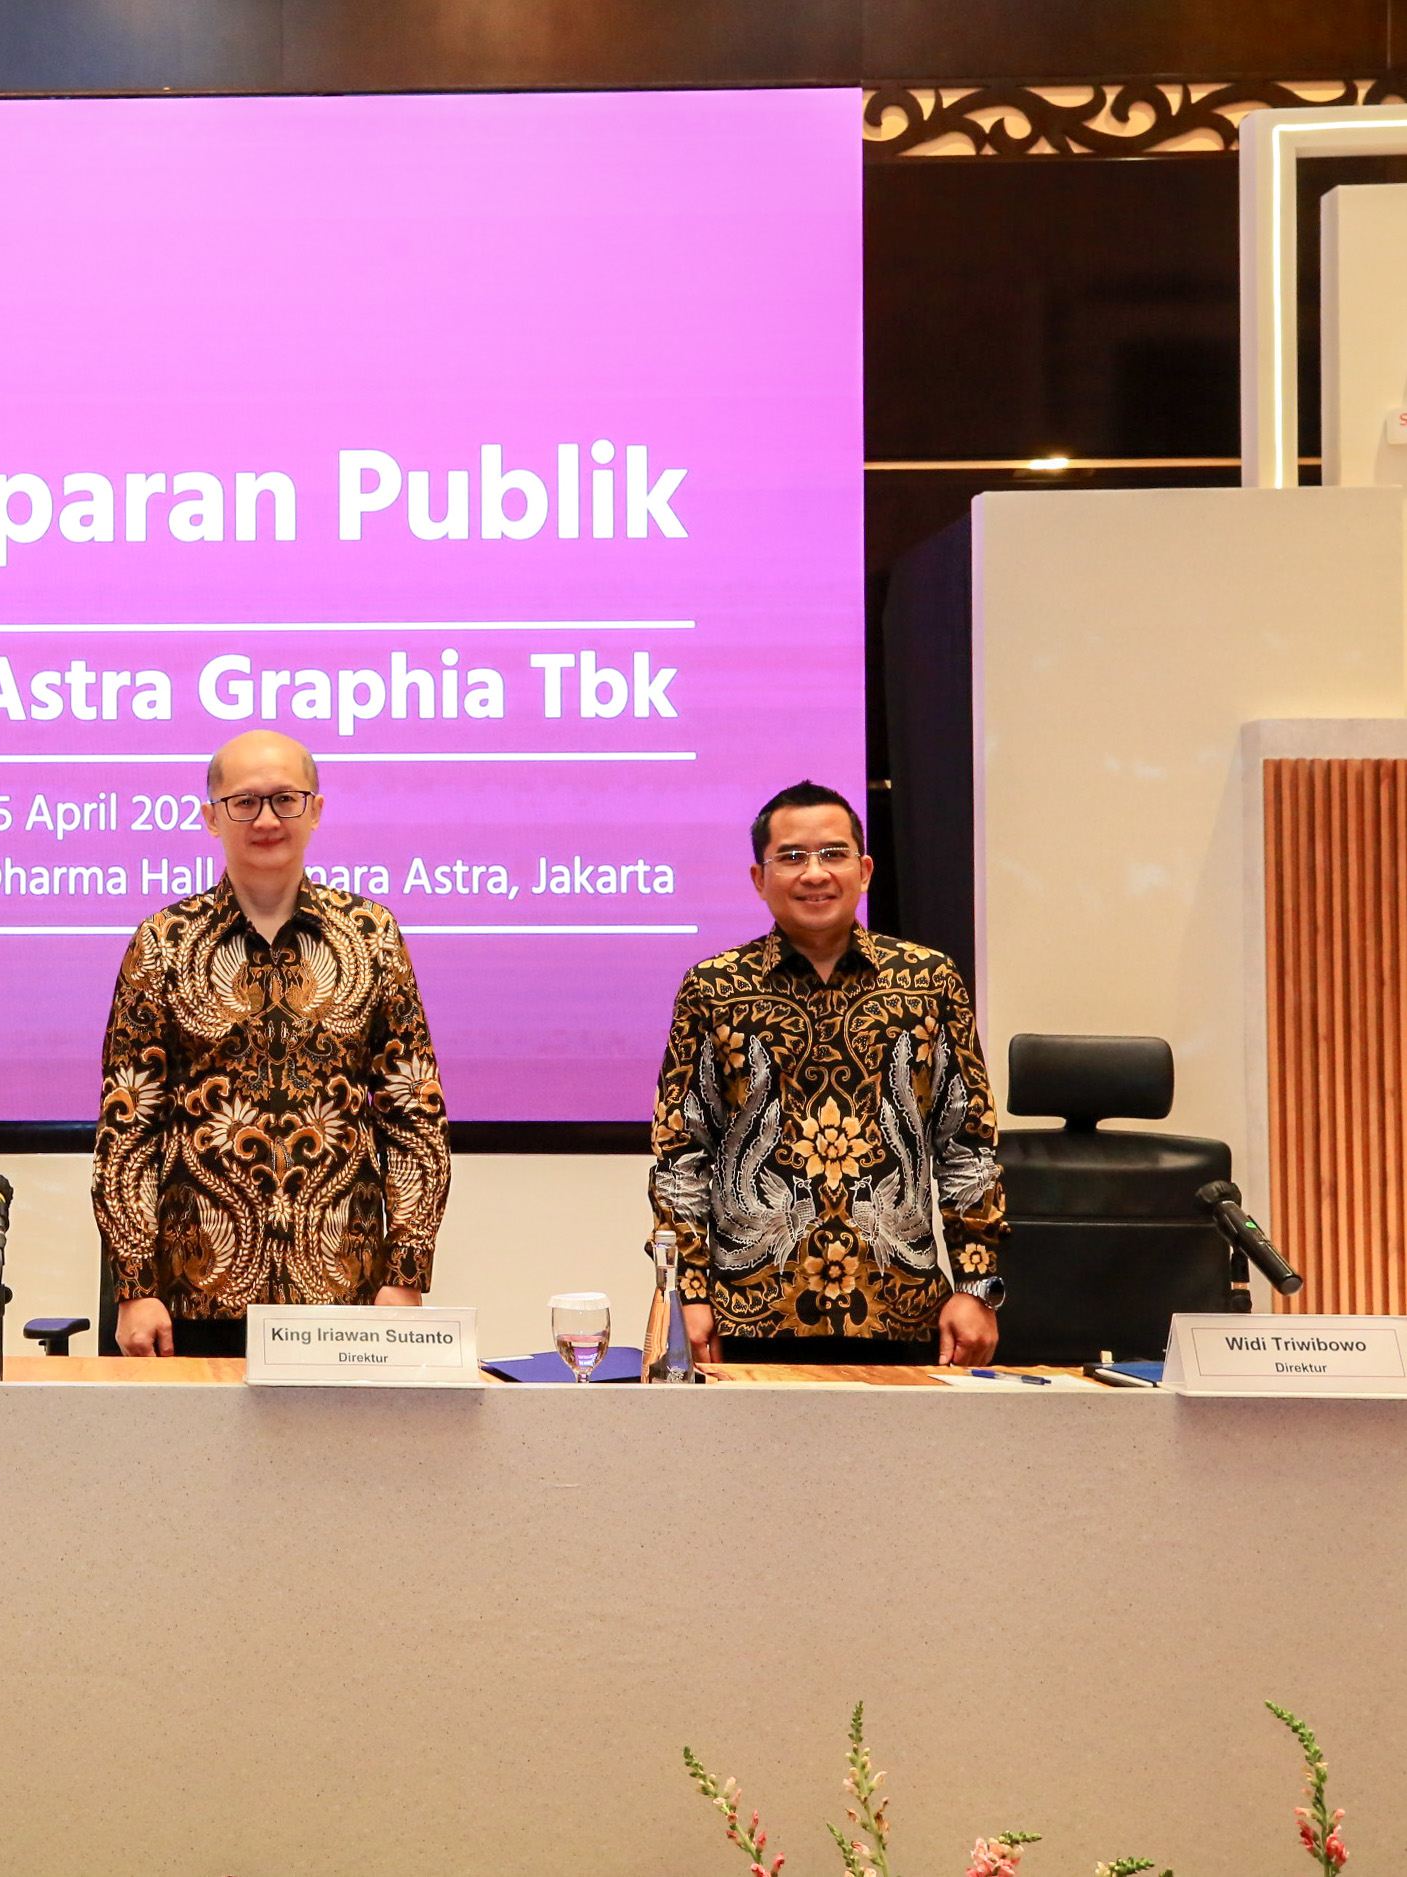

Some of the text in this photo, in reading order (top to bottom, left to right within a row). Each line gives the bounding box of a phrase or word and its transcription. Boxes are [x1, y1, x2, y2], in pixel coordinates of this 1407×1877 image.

[338, 439, 689, 541] Publik
[198, 648, 504, 737] Graphia
[530, 650, 678, 718] Tbk
[25, 792, 117, 840] April
[130, 795, 202, 831] 202
[403, 857, 519, 900] Astra,
[531, 855, 674, 894] Jakarta
[271, 1327, 453, 1345] King Iriawan Sutanto
[1225, 1336, 1367, 1352] Widi Triwibowo
[338, 1352, 388, 1364] Direktur
[1275, 1362, 1327, 1373] Direktur
